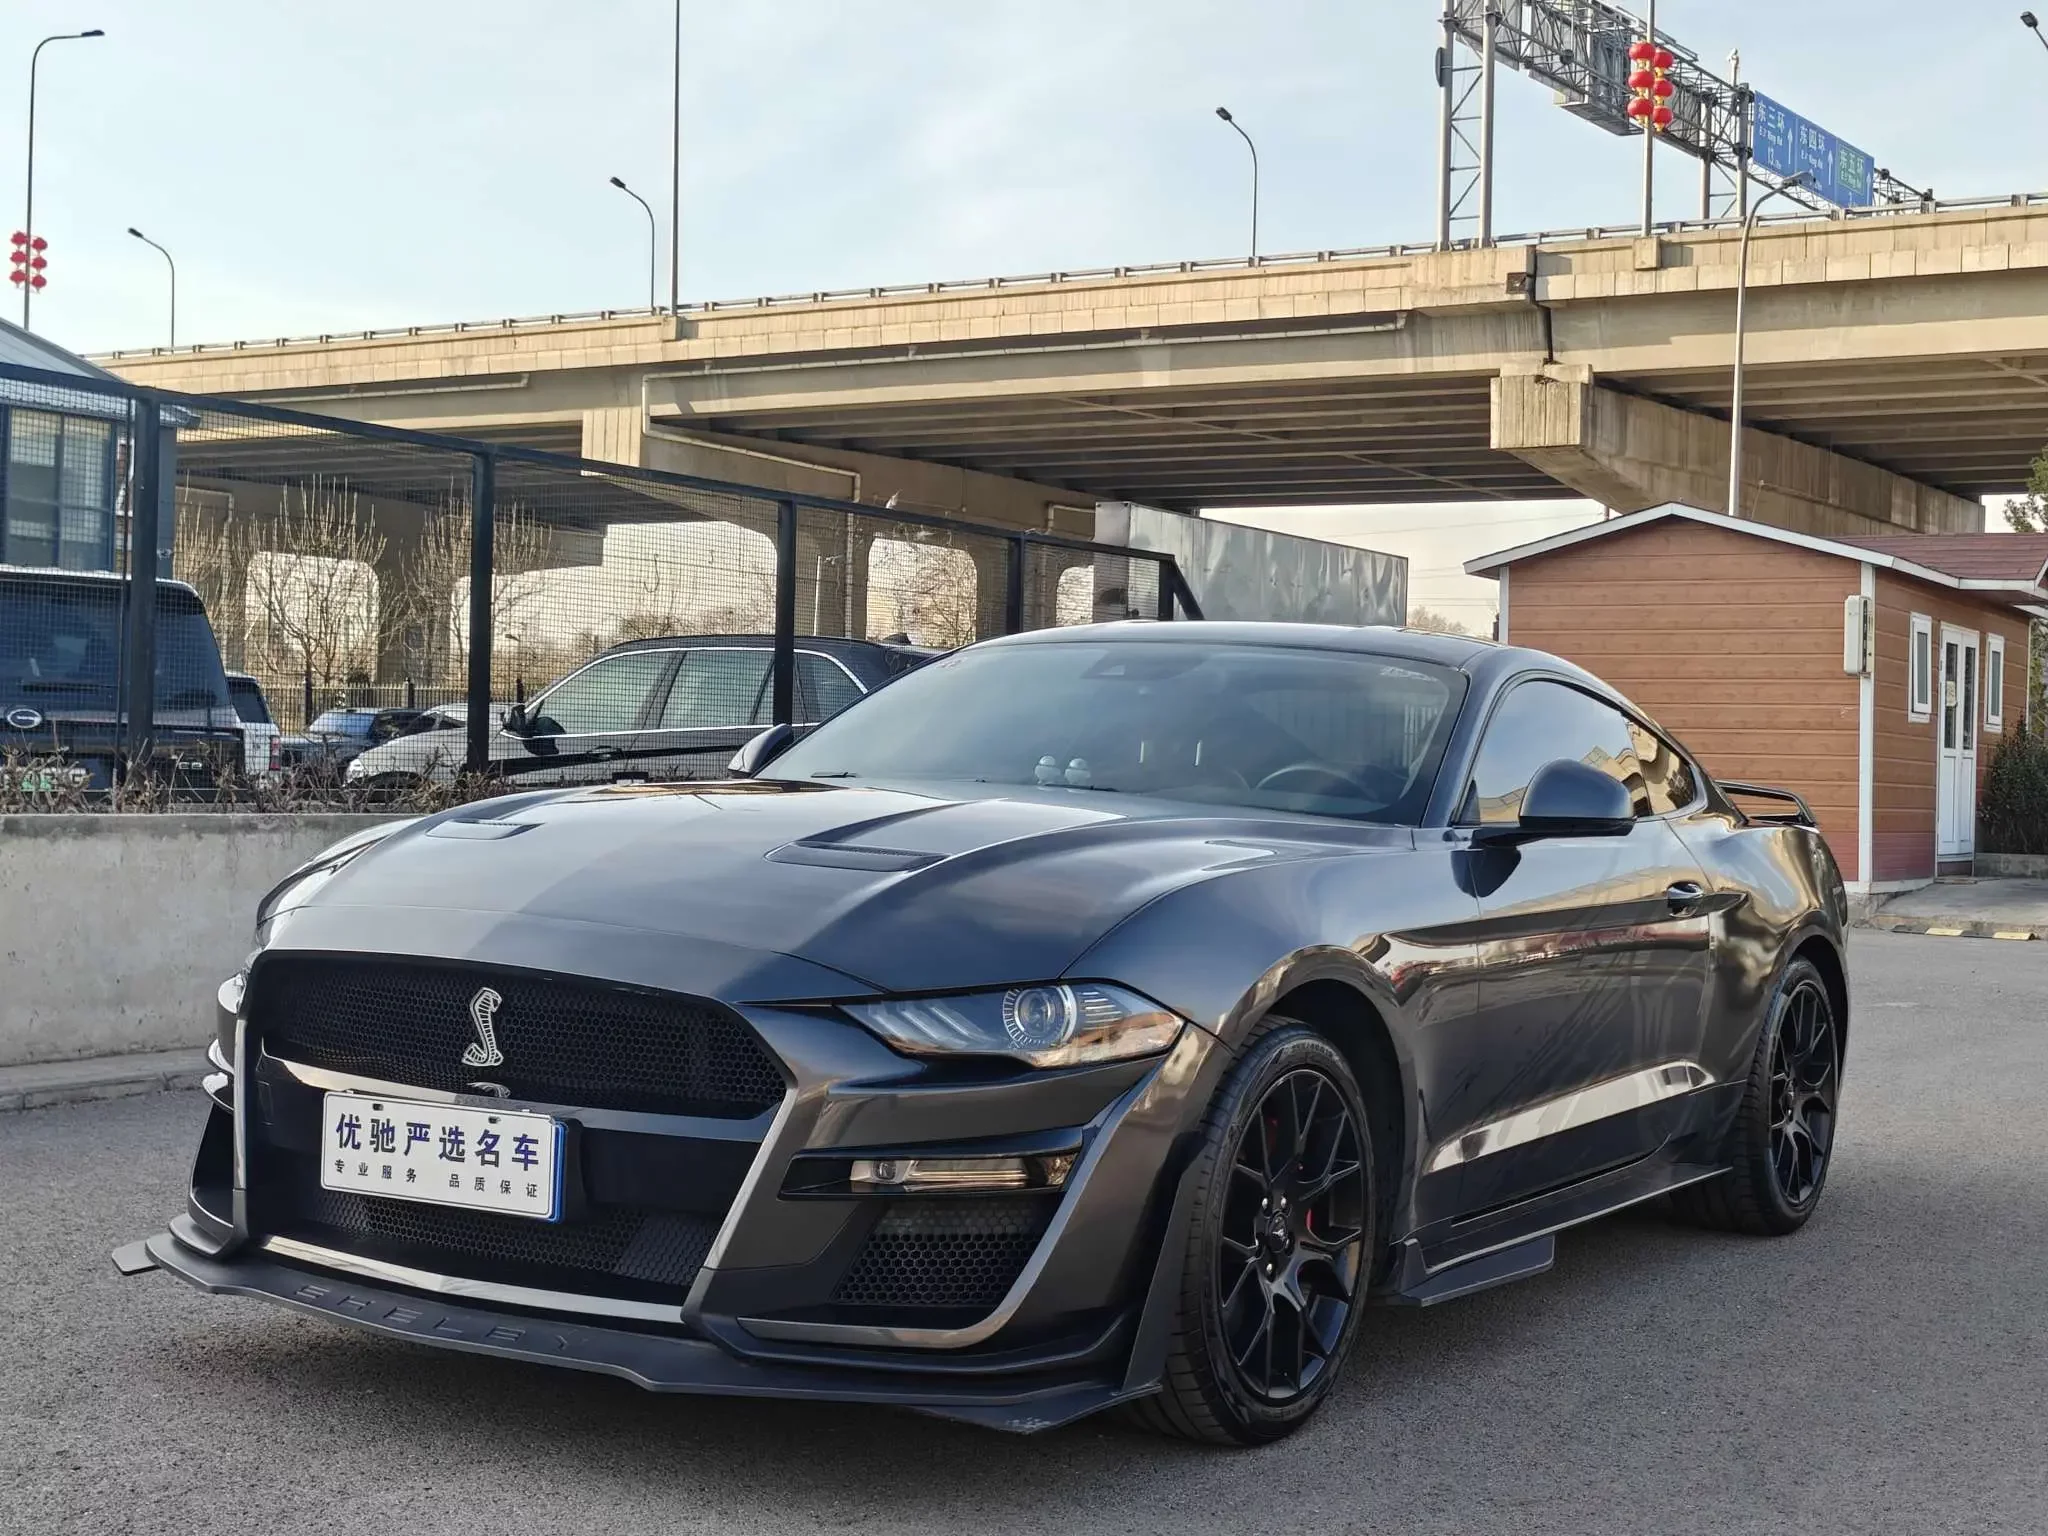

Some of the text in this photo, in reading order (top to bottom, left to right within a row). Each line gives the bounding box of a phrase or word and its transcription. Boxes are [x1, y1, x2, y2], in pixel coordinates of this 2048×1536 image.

[1758, 100, 1785, 133] 东三环
[1800, 125, 1825, 154] 东四环
[335, 1113, 539, 1172] 优驰严选名车
[335, 1160, 539, 1199] 专业服务 品质保证
[292, 1286, 588, 1351] SHELBY
